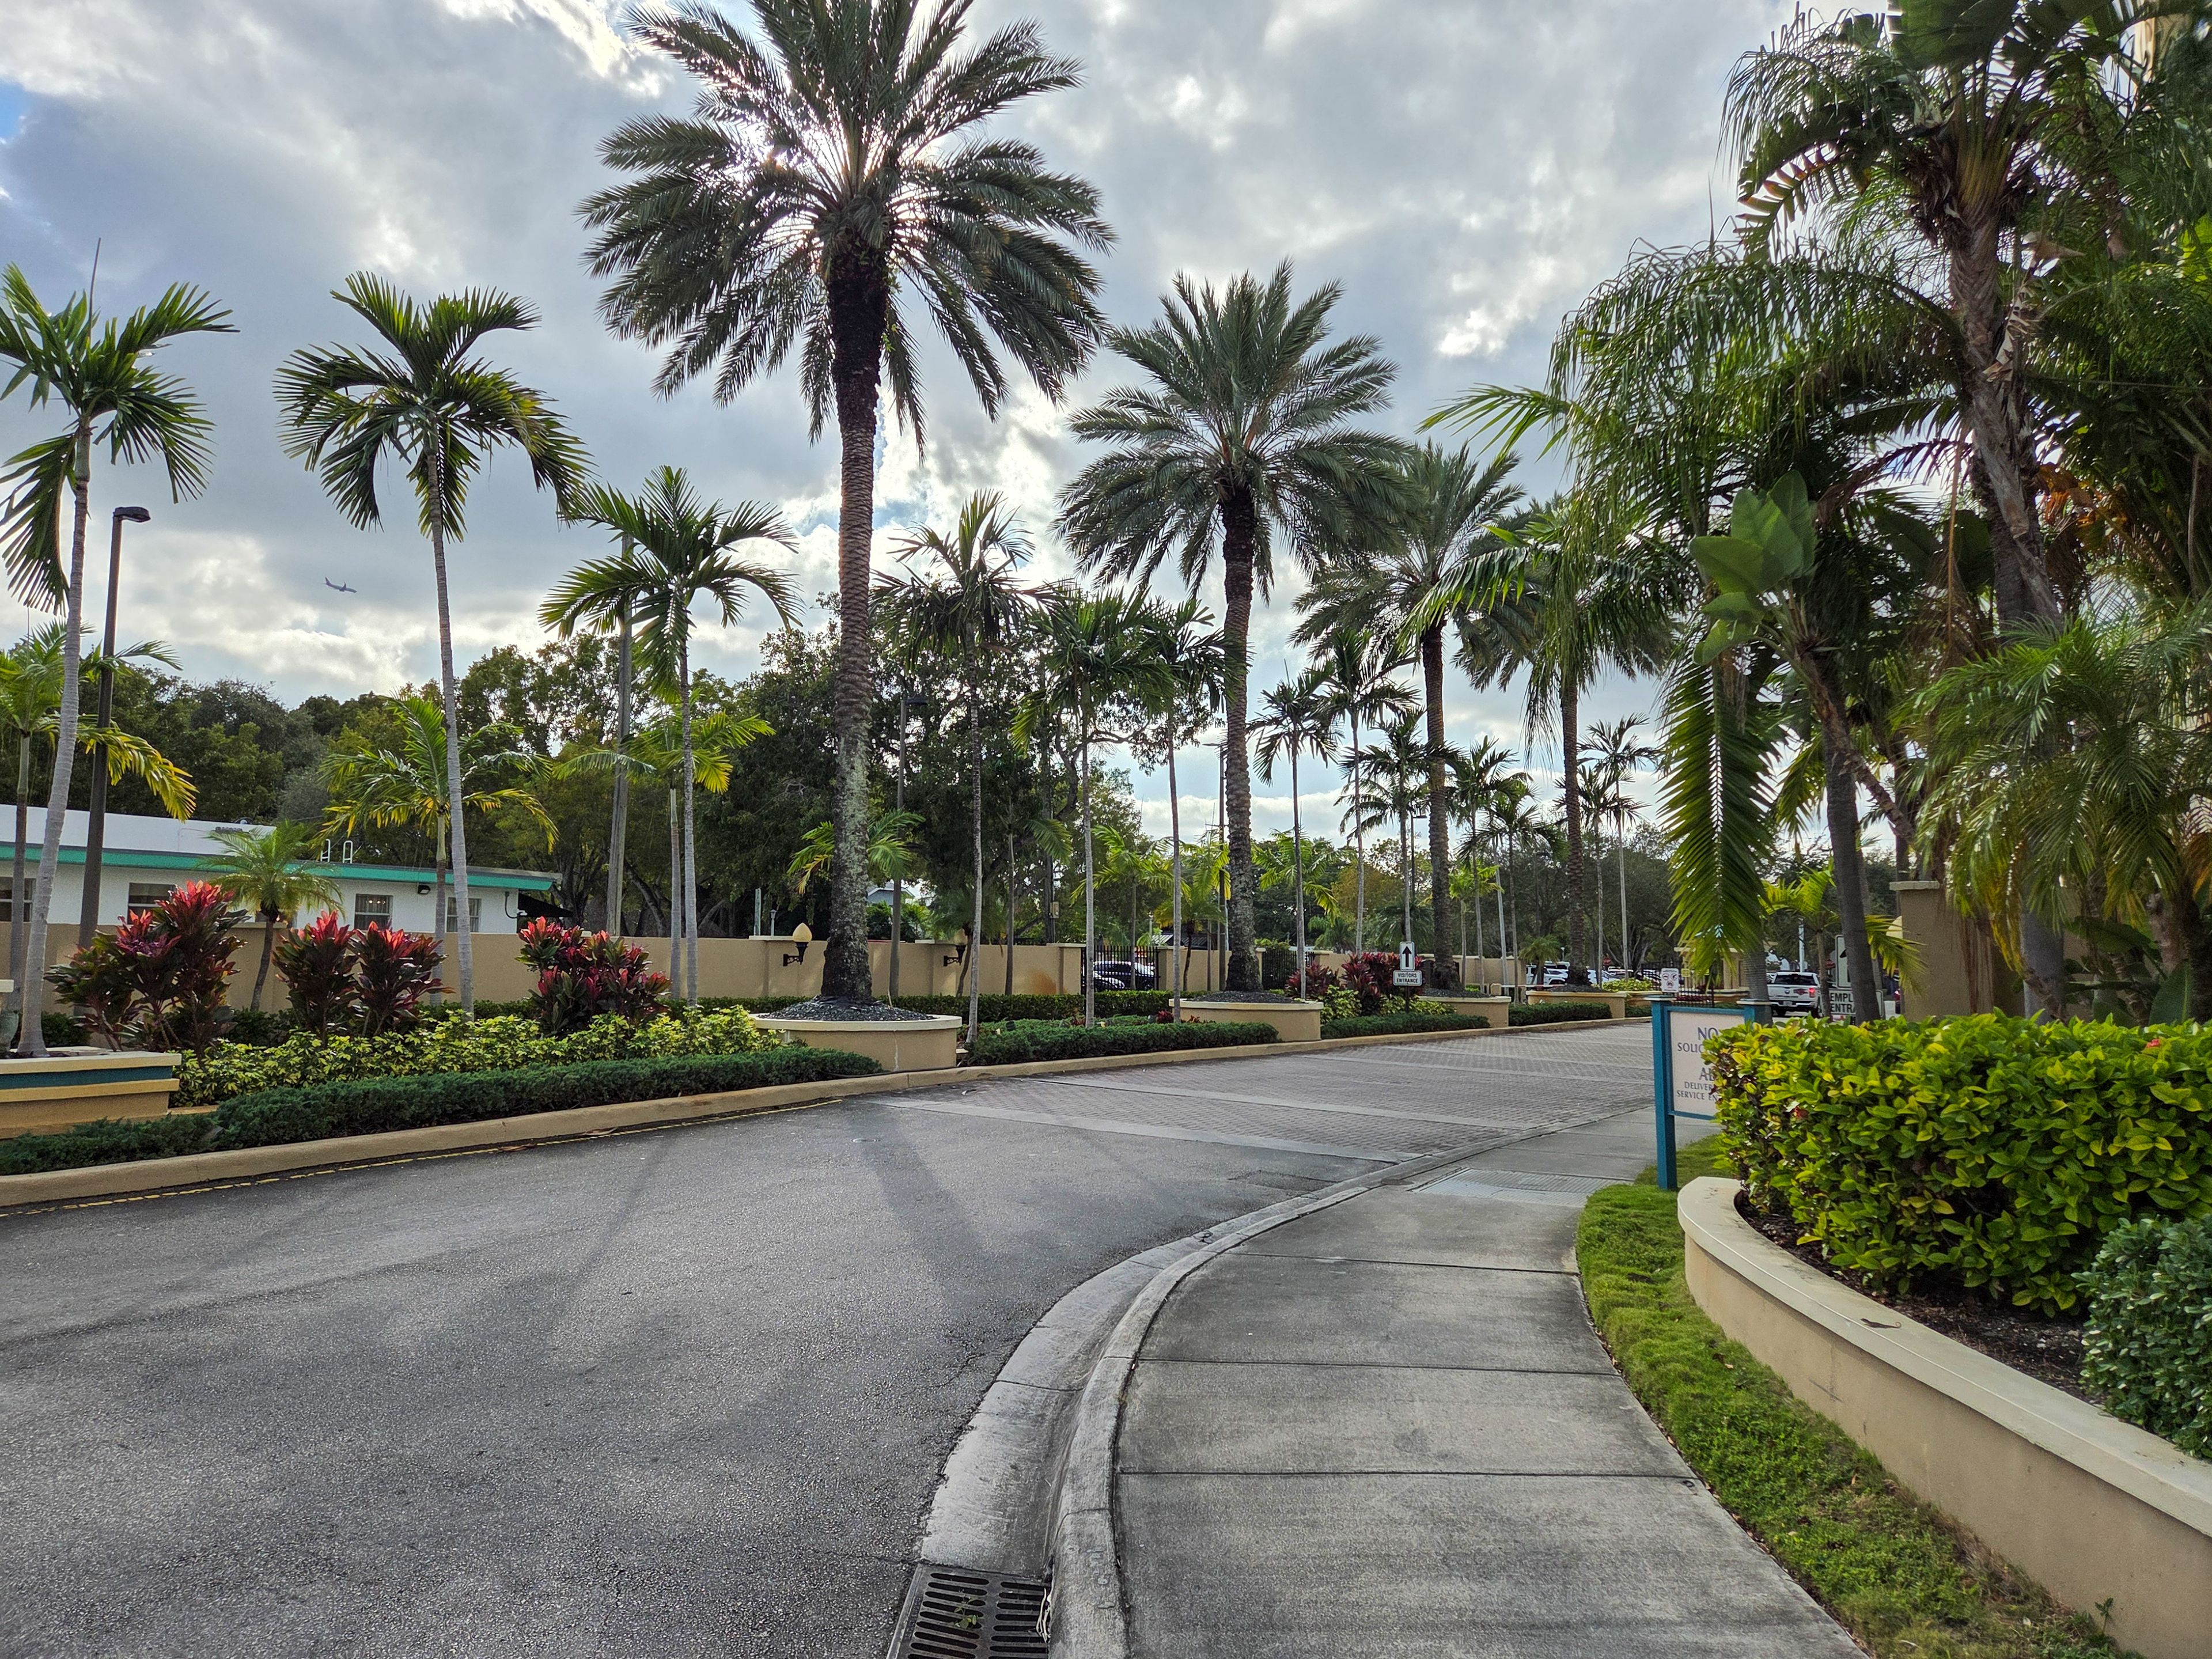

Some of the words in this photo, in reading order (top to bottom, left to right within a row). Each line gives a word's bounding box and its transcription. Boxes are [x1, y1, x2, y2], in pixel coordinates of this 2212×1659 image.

[1830, 993, 1853, 1002] EMPL
[1831, 1003, 1855, 1013] ENTR
[1698, 1027, 1718, 1040] NO
[1677, 1042, 1703, 1054] SOLIC
[1684, 1081, 1713, 1090] DELIVER
[1677, 1090, 1705, 1100] SERVICE
